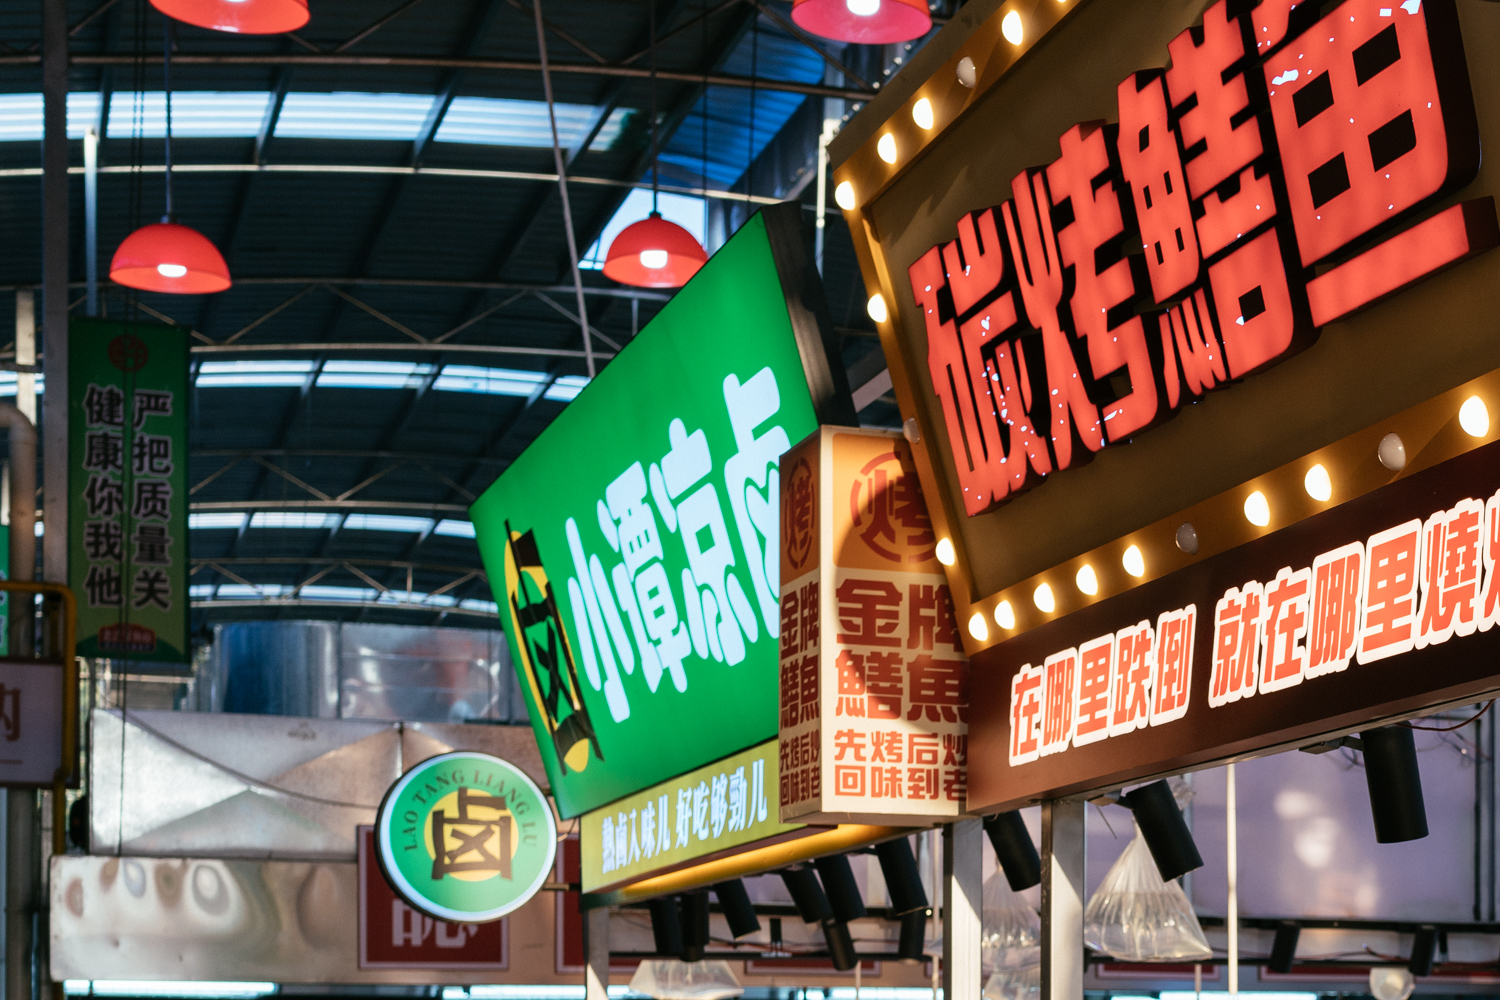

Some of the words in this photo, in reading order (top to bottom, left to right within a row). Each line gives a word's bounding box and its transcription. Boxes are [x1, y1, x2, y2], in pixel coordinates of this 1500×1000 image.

[83, 383, 125, 608] 健康你我他
[131, 388, 174, 611] 严把质量关
[780, 580, 819, 660] 金牌
[836, 578, 965, 653] 金牌
[1009, 604, 1197, 767] 在哪里跌倒
[780, 729, 820, 773] 先烤后炒
[780, 765, 820, 807] 回味到老
[834, 729, 968, 767] 先烤后炒
[835, 765, 968, 801] 回味到老
[402, 809, 420, 853] LAO
[411, 769, 466, 807] TANG
[473, 769, 531, 816] LIANG
[521, 820, 538, 849] LU
